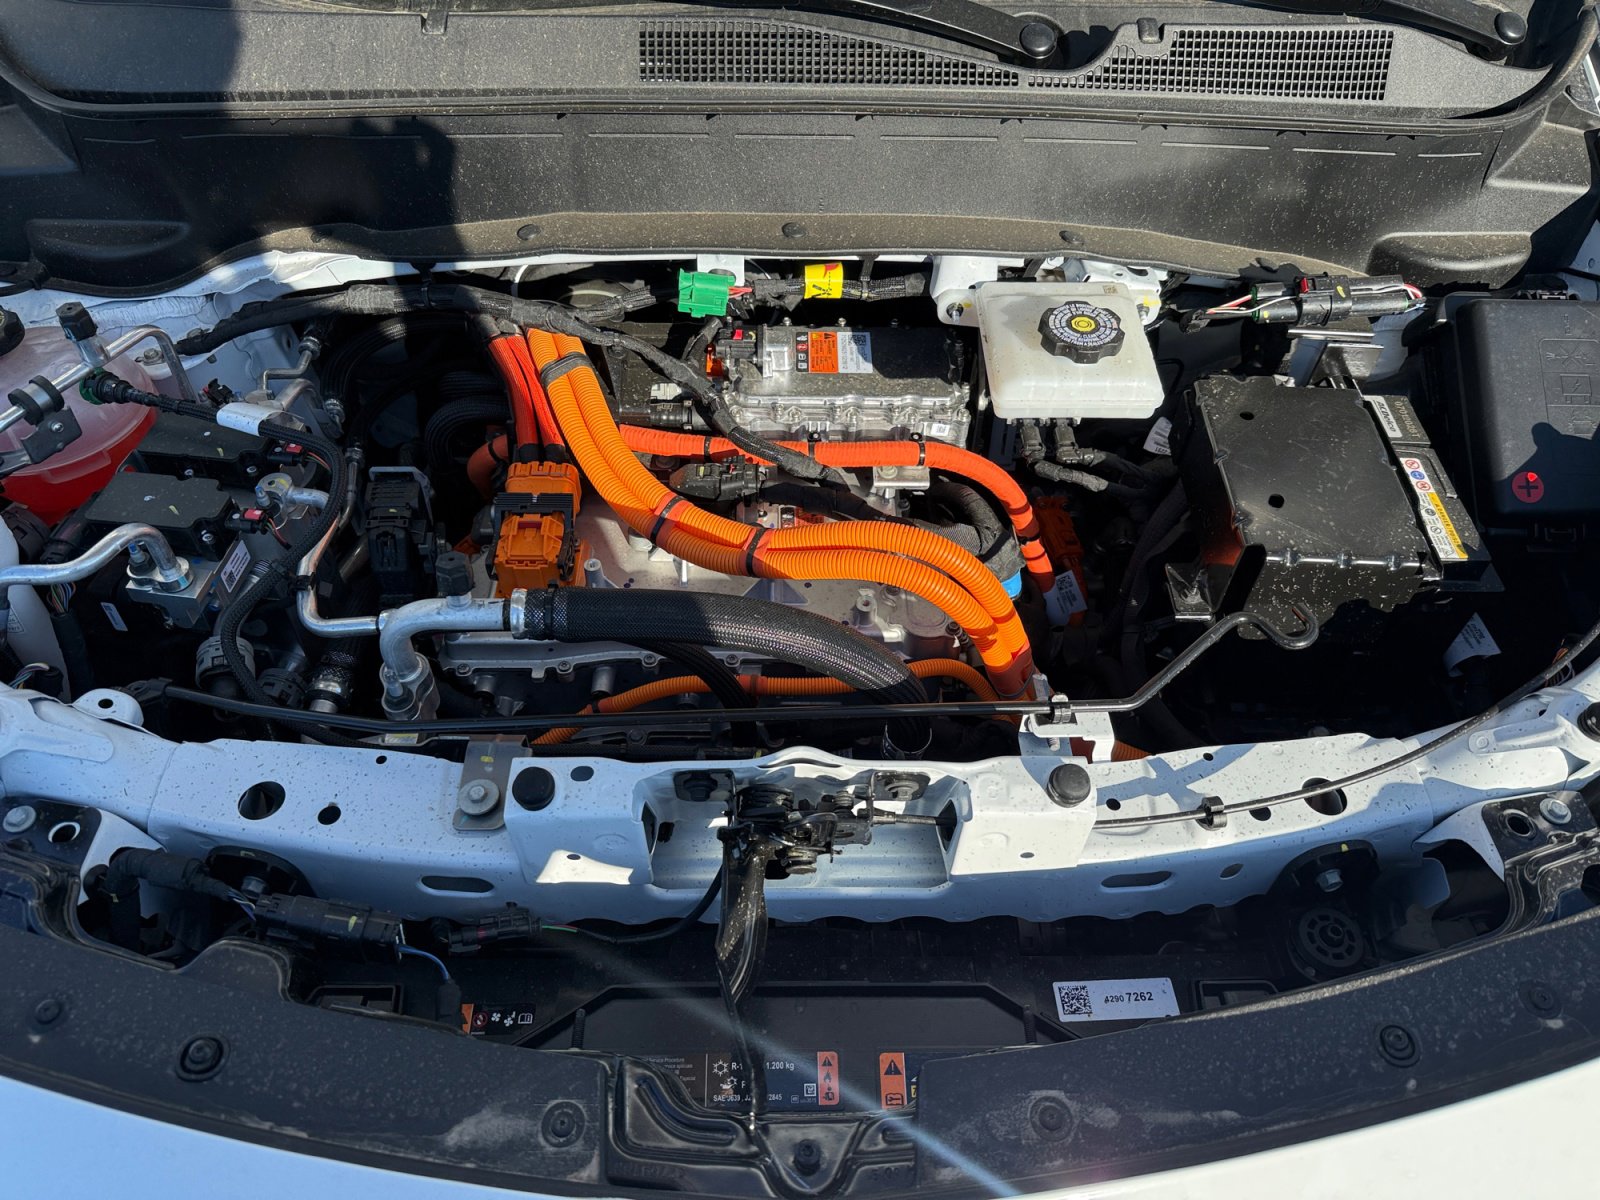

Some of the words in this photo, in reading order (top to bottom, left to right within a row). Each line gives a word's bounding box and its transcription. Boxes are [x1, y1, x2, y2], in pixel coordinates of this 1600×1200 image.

[1126, 991, 1154, 1003] 7262
[766, 1062, 784, 1070] 1.200
[785, 1062, 795, 1071] kg
